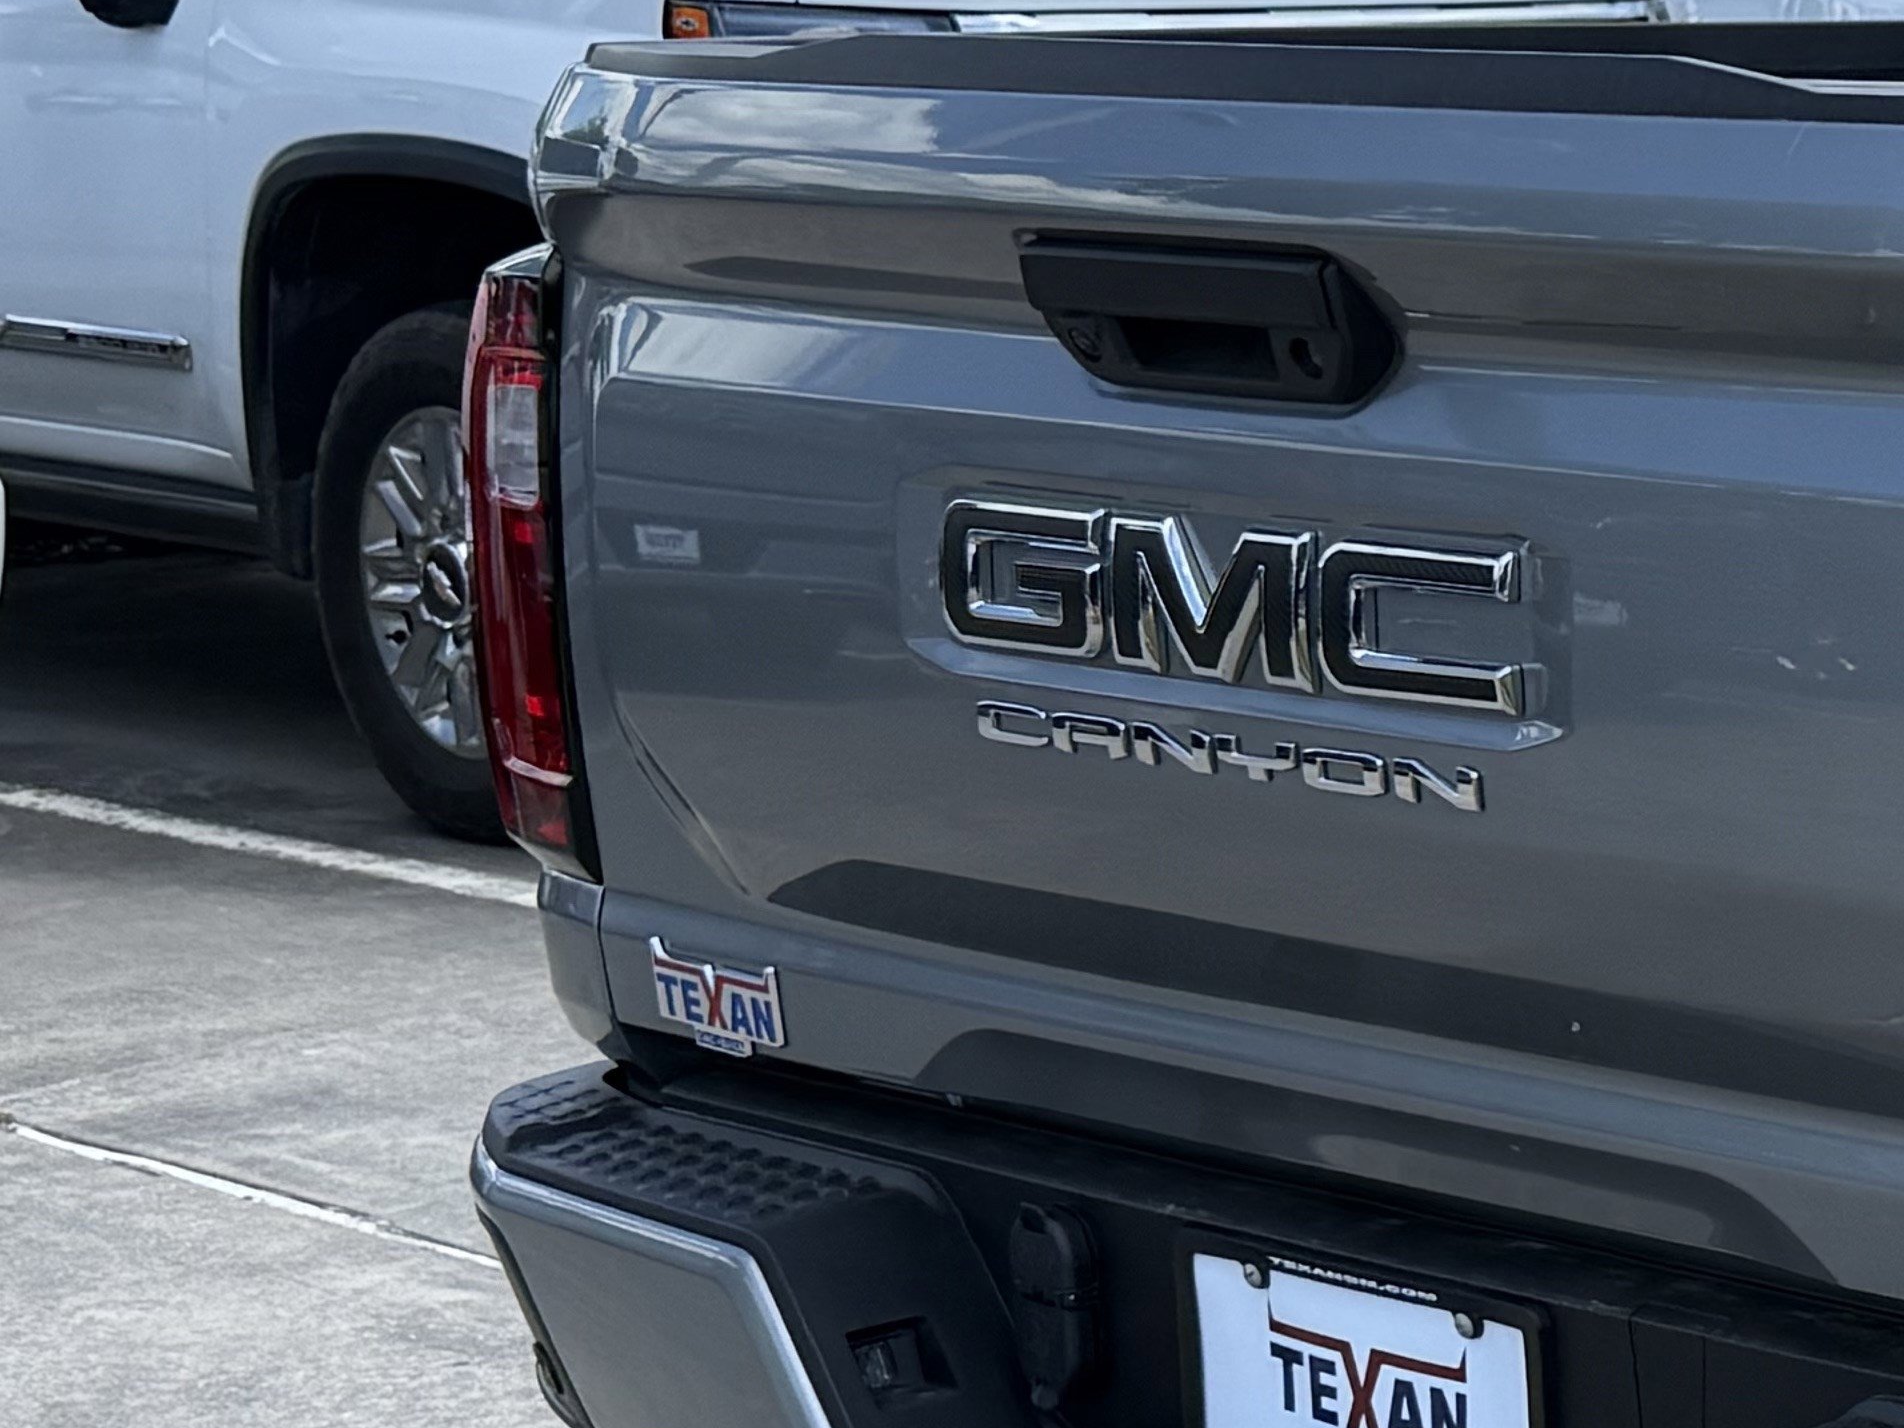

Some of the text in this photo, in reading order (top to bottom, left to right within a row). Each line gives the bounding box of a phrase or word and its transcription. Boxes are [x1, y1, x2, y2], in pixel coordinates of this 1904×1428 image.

[939, 498, 1530, 717] GMC
[976, 699, 1485, 812] CANYON
[654, 950, 779, 1044] TEXAN
